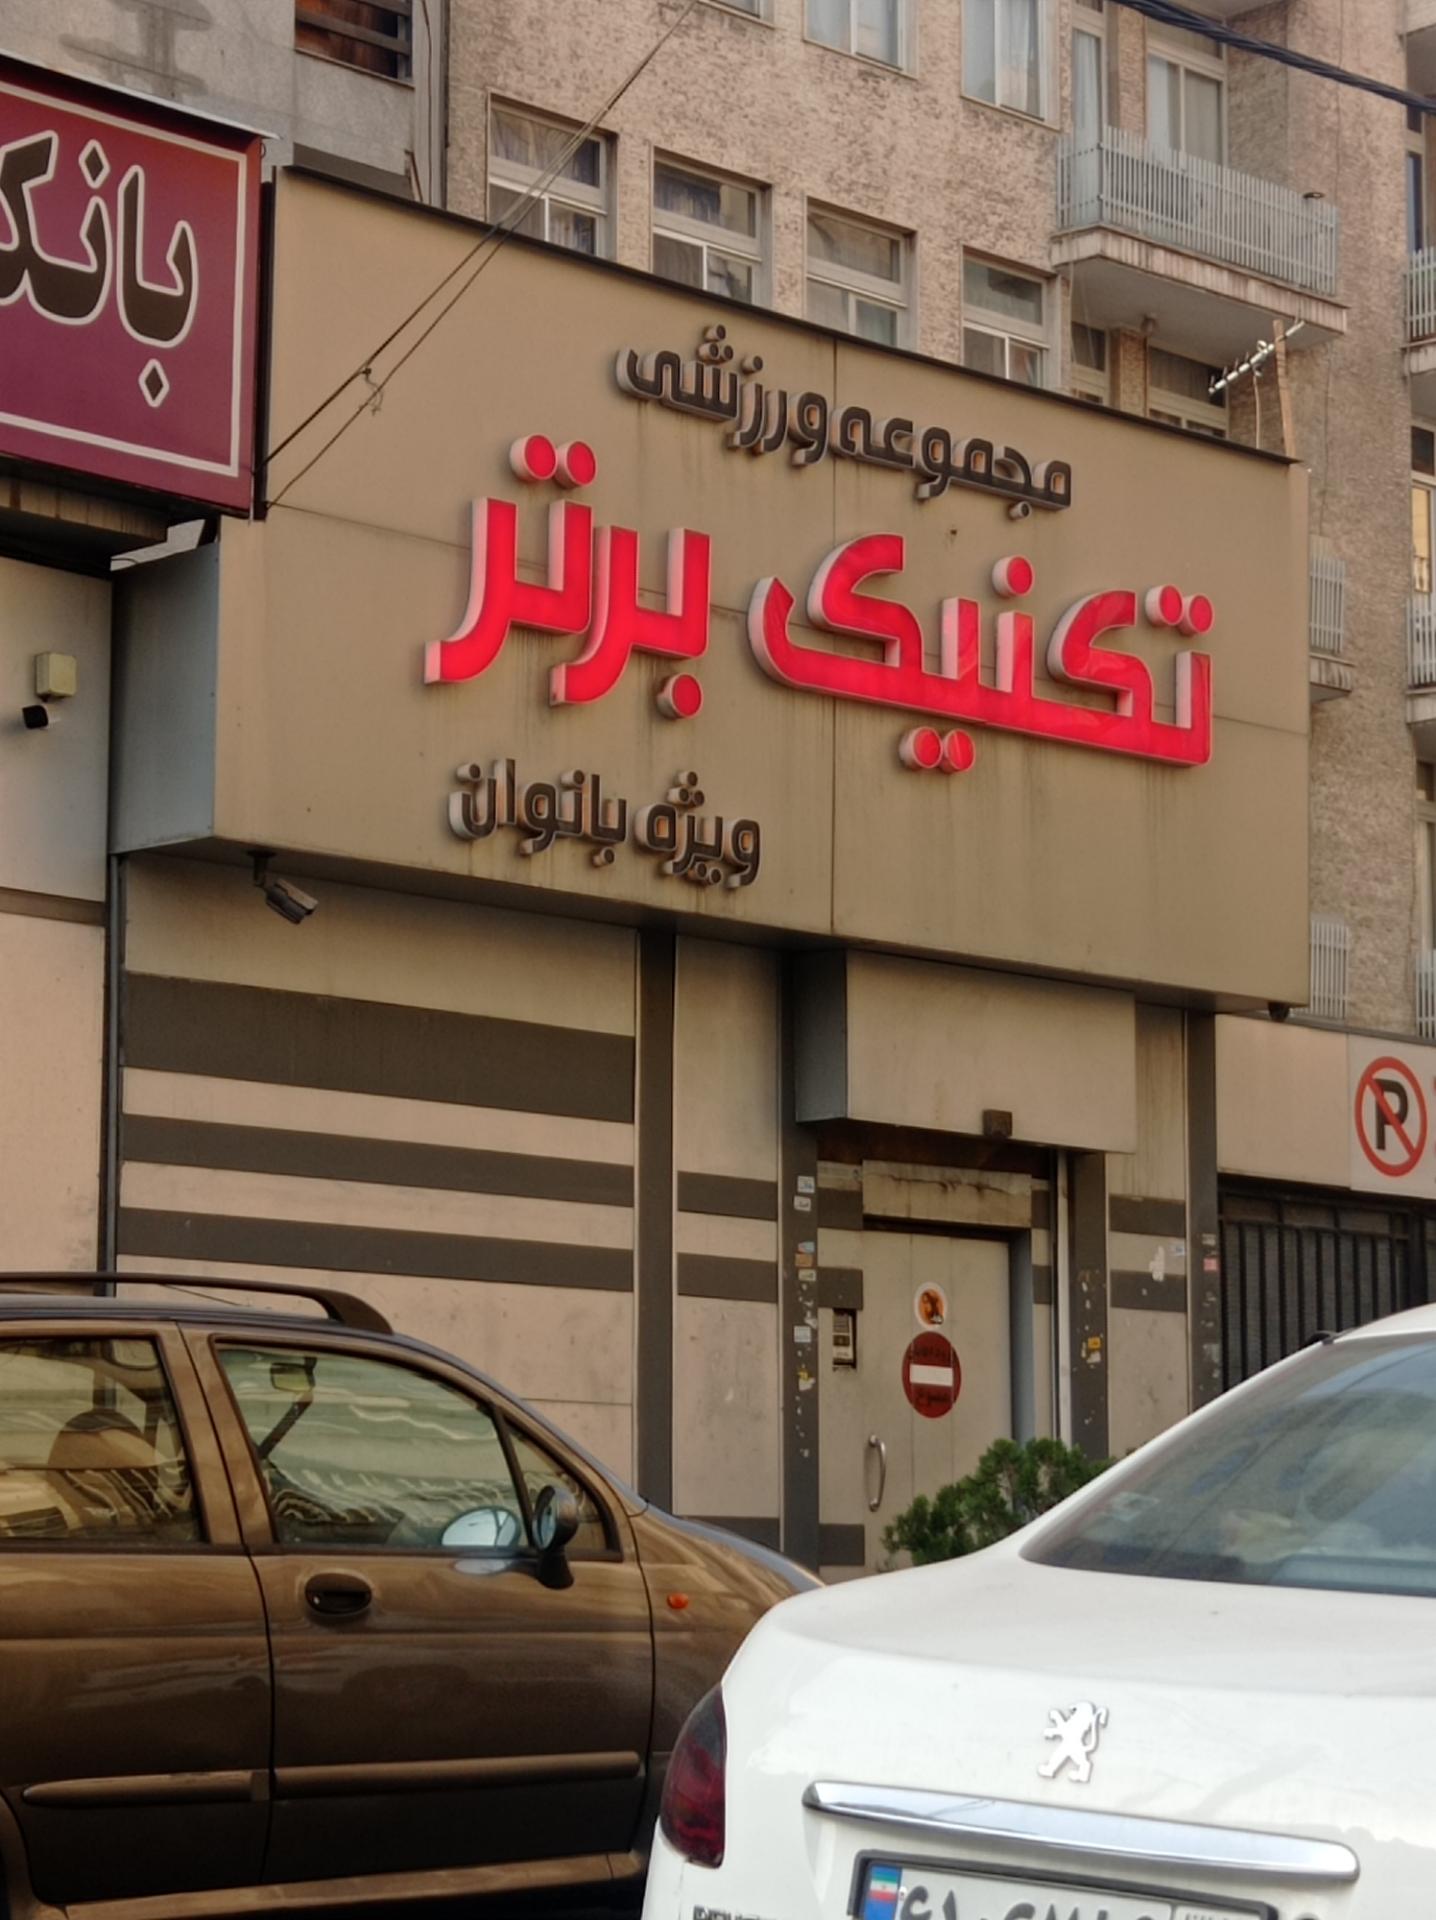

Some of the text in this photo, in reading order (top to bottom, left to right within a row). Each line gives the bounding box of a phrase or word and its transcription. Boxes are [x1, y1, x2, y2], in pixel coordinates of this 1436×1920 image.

[616, 323, 829, 466] ورزشی
[424, 433, 1213, 774] تکنیک برتر
[448, 757, 761, 888] ویژه بانوان
